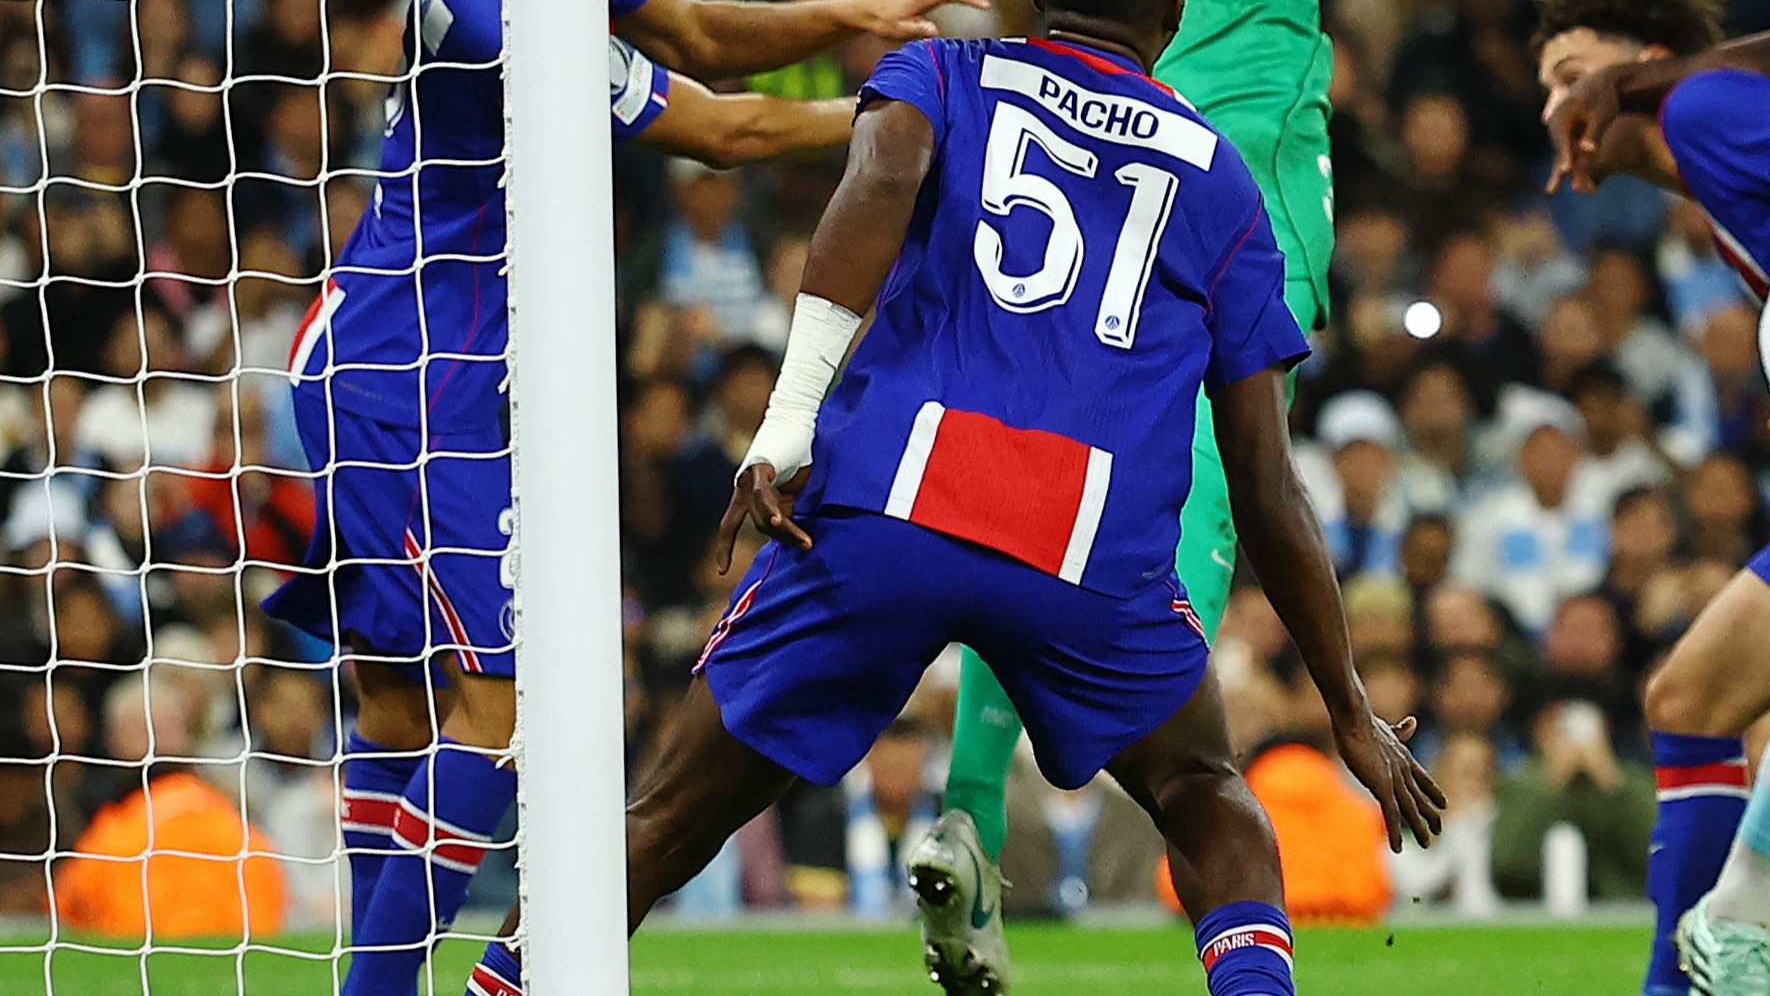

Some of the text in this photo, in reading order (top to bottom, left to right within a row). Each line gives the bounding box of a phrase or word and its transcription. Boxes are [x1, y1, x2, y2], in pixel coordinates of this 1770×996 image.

[1039, 74, 1160, 140] PACHO
[973, 100, 1180, 350] 51
[1213, 933, 1255, 957] PARIS
